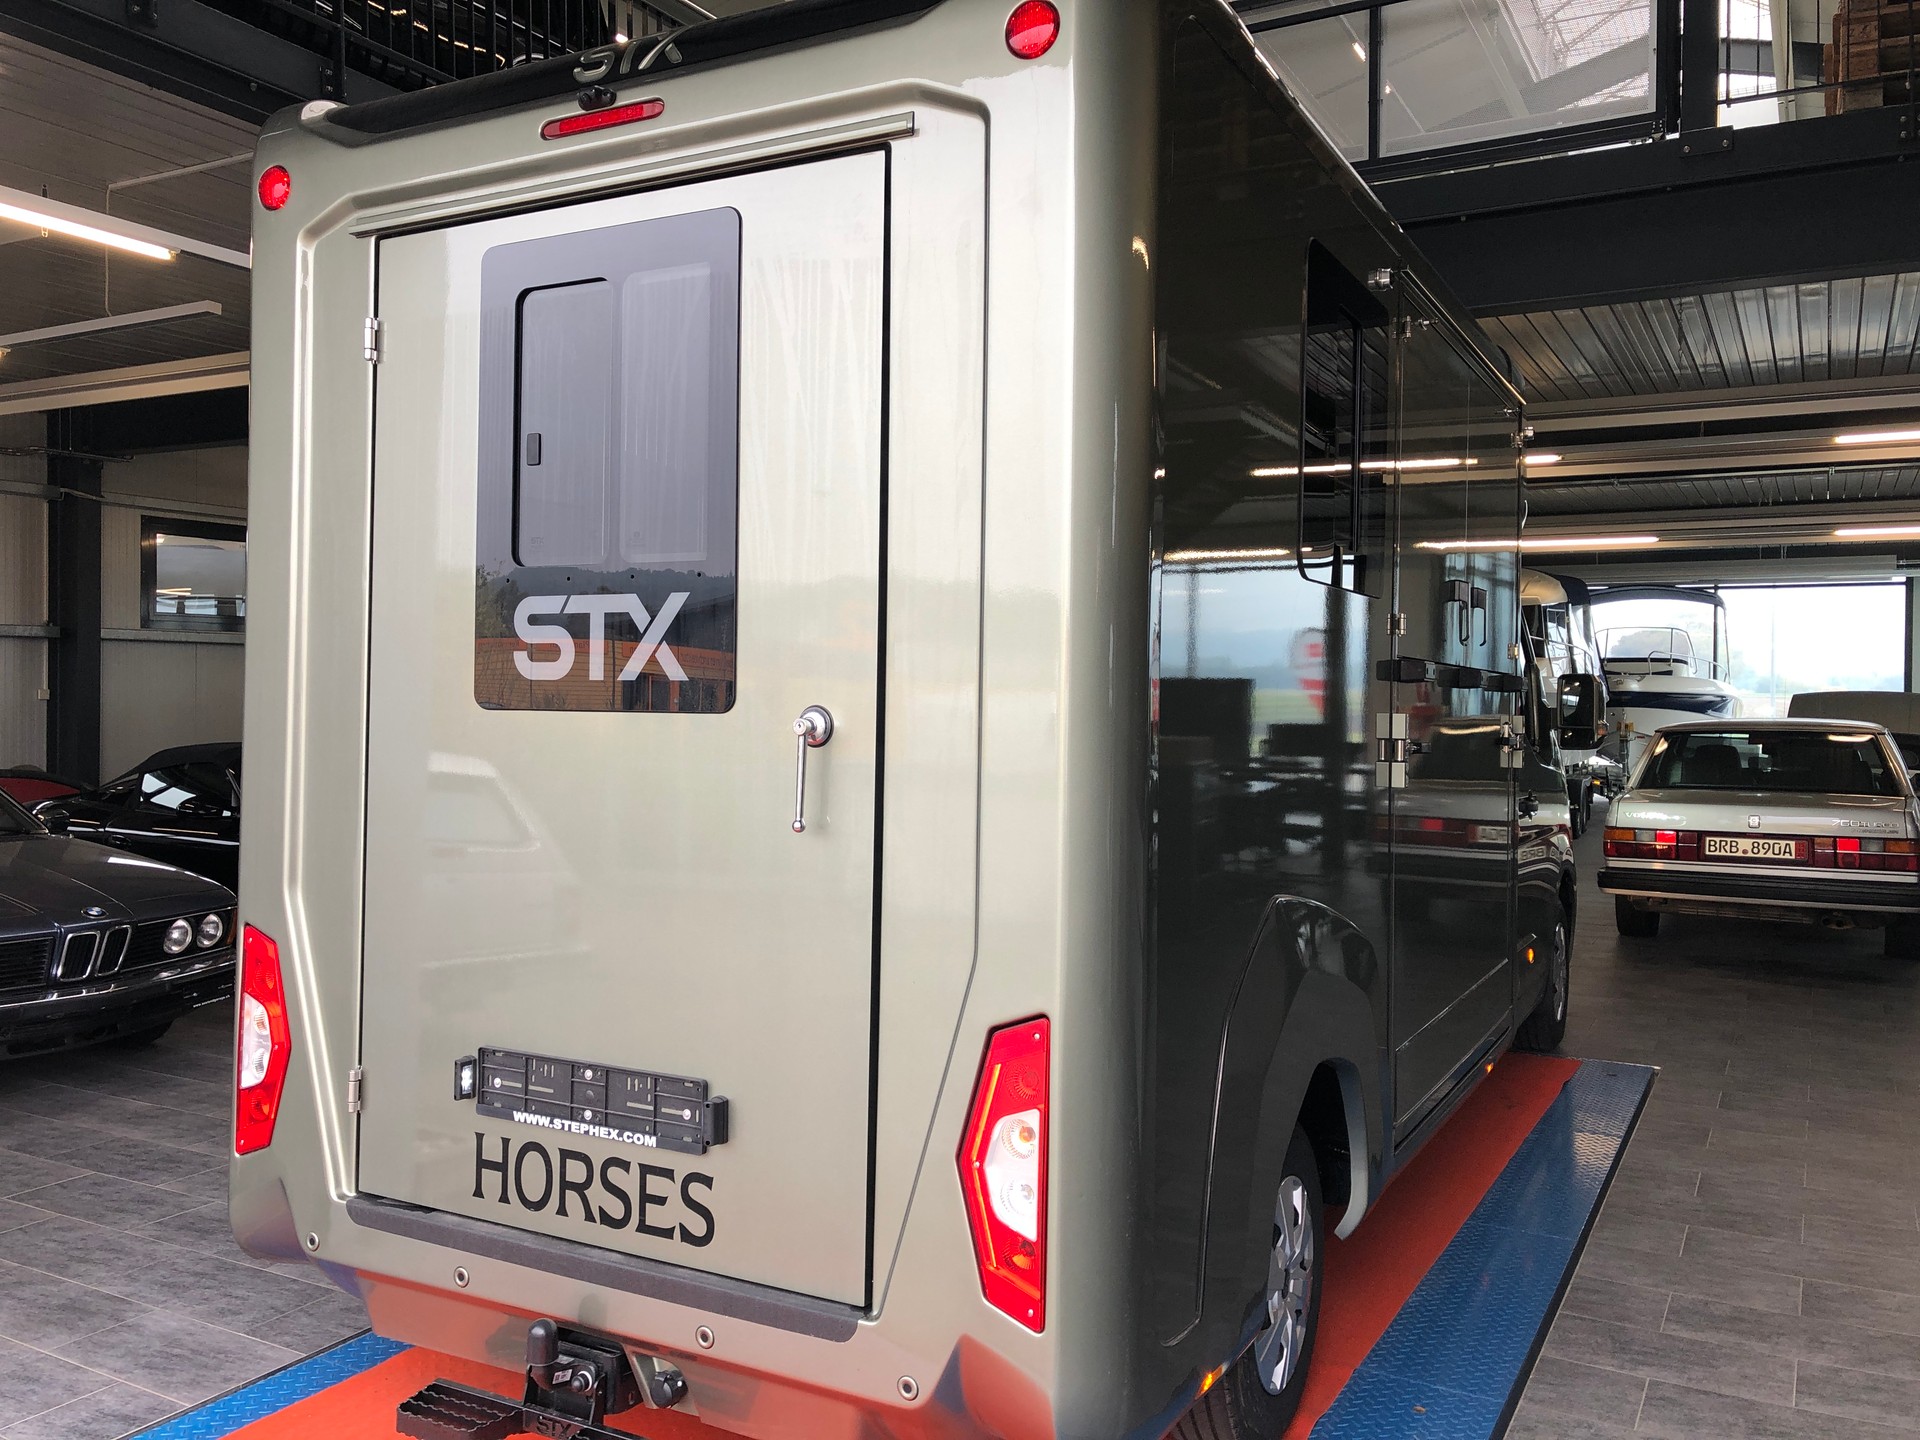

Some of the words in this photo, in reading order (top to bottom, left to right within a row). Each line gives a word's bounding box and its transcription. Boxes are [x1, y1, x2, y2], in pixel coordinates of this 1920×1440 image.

[513, 592, 691, 681] STX
[1707, 839, 1739, 853] BRB
[1751, 841, 1793, 857] 890A
[513, 1110, 657, 1148] WWW.STEPHEX.COM
[472, 1131, 715, 1248] HORSES
